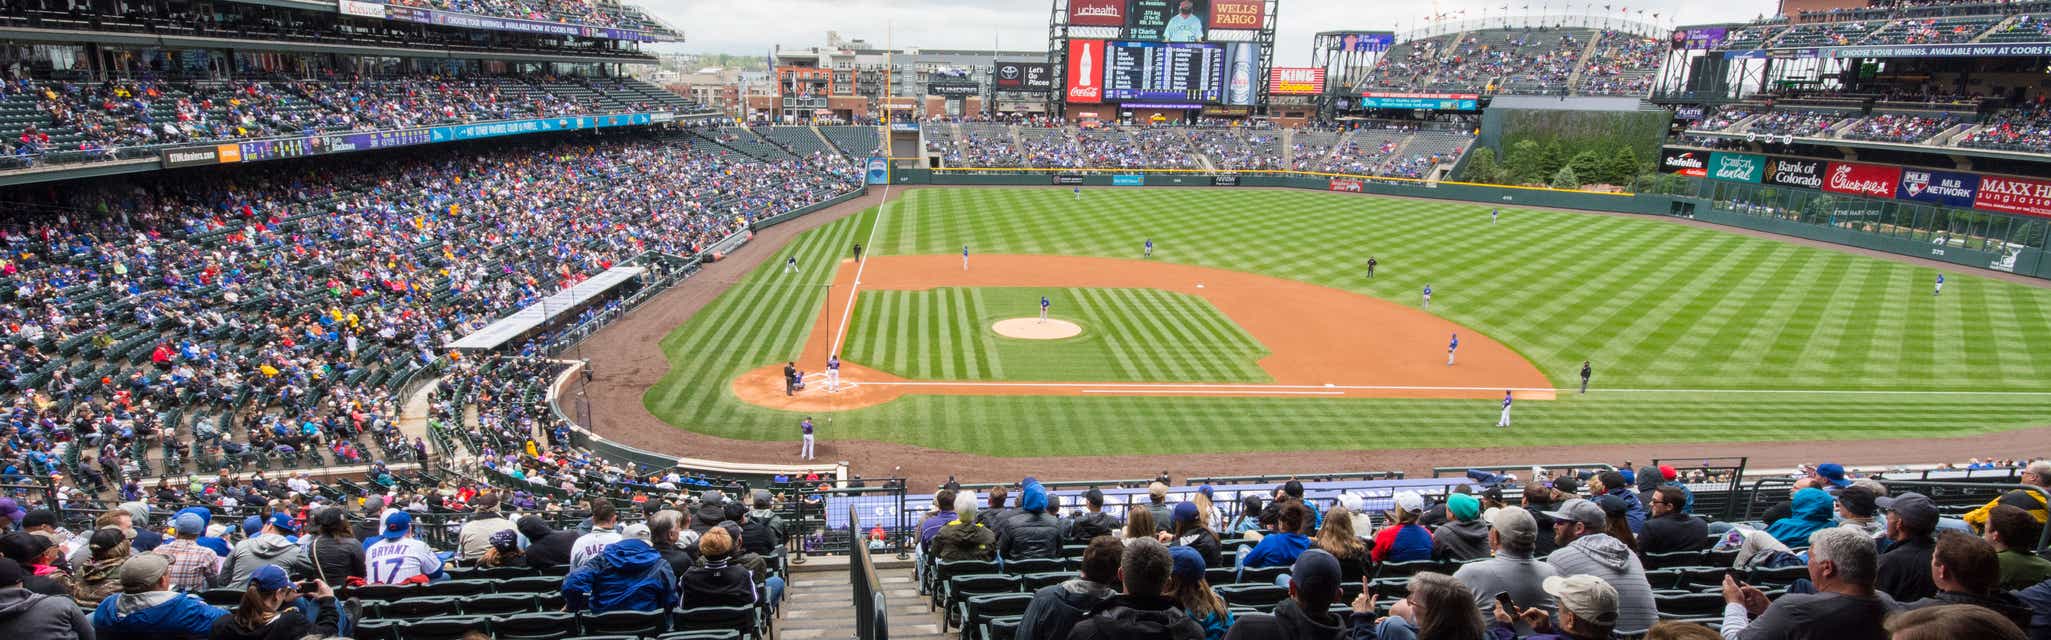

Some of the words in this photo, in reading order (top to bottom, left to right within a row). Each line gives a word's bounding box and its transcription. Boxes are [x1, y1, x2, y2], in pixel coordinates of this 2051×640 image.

[1077, 4, 1118, 16] uchealth
[1216, 4, 1258, 14] WELLS
[1216, 14, 1257, 24] FARGO
[1872, 48, 1893, 56] YOUR
[1930, 47, 1971, 56] AVAILABLE
[1973, 46, 1997, 55] NOW
[1998, 46, 2010, 55] AT
[2011, 46, 2043, 55] COORS
[1028, 66, 1044, 74] Let's
[1280, 69, 1315, 81] KING
[935, 86, 977, 94] TUNDRA
[1680, 108, 1701, 116] PLATTE
[1666, 156, 1703, 169] Safelite
[1720, 156, 1752, 168] Comfort
[1777, 160, 1803, 173] Bank
[1804, 162, 1817, 174] of
[1716, 165, 1755, 180] dental
[1905, 171, 1929, 181] MLB
[1776, 172, 1821, 186] Colorado
[1830, 166, 1889, 194] Chick-fil-A
[1941, 179, 1962, 188] MLB
[1926, 185, 1973, 198] NETWORK
[1981, 178, 2034, 196] MAXX
[1849, 208, 1880, 216] HARTORD
[372, 545, 409, 559] BRYANT
[372, 557, 404, 585] 17
